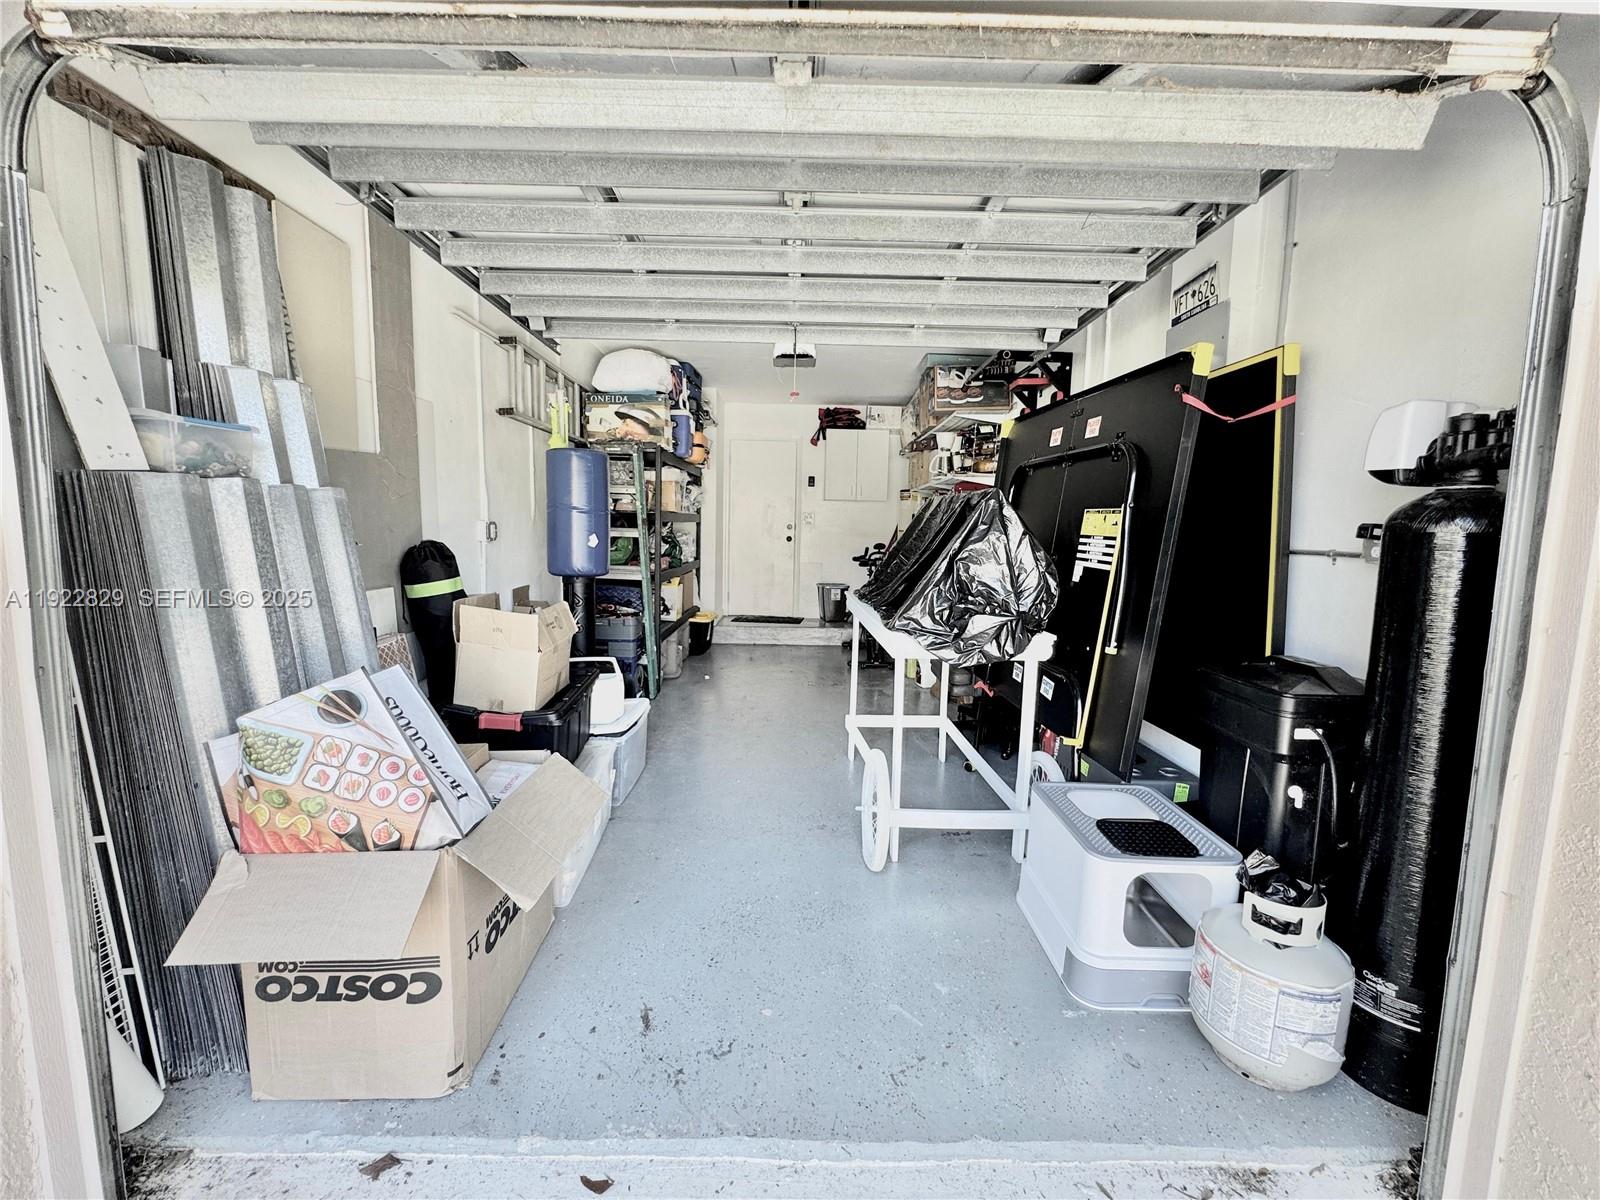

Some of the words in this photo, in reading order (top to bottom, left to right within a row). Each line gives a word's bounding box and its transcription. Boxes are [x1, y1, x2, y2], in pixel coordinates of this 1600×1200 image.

[1197, 276, 1216, 302] 626
[590, 394, 629, 403] ONEIDA
[254, 971, 443, 1004] COSTCO
